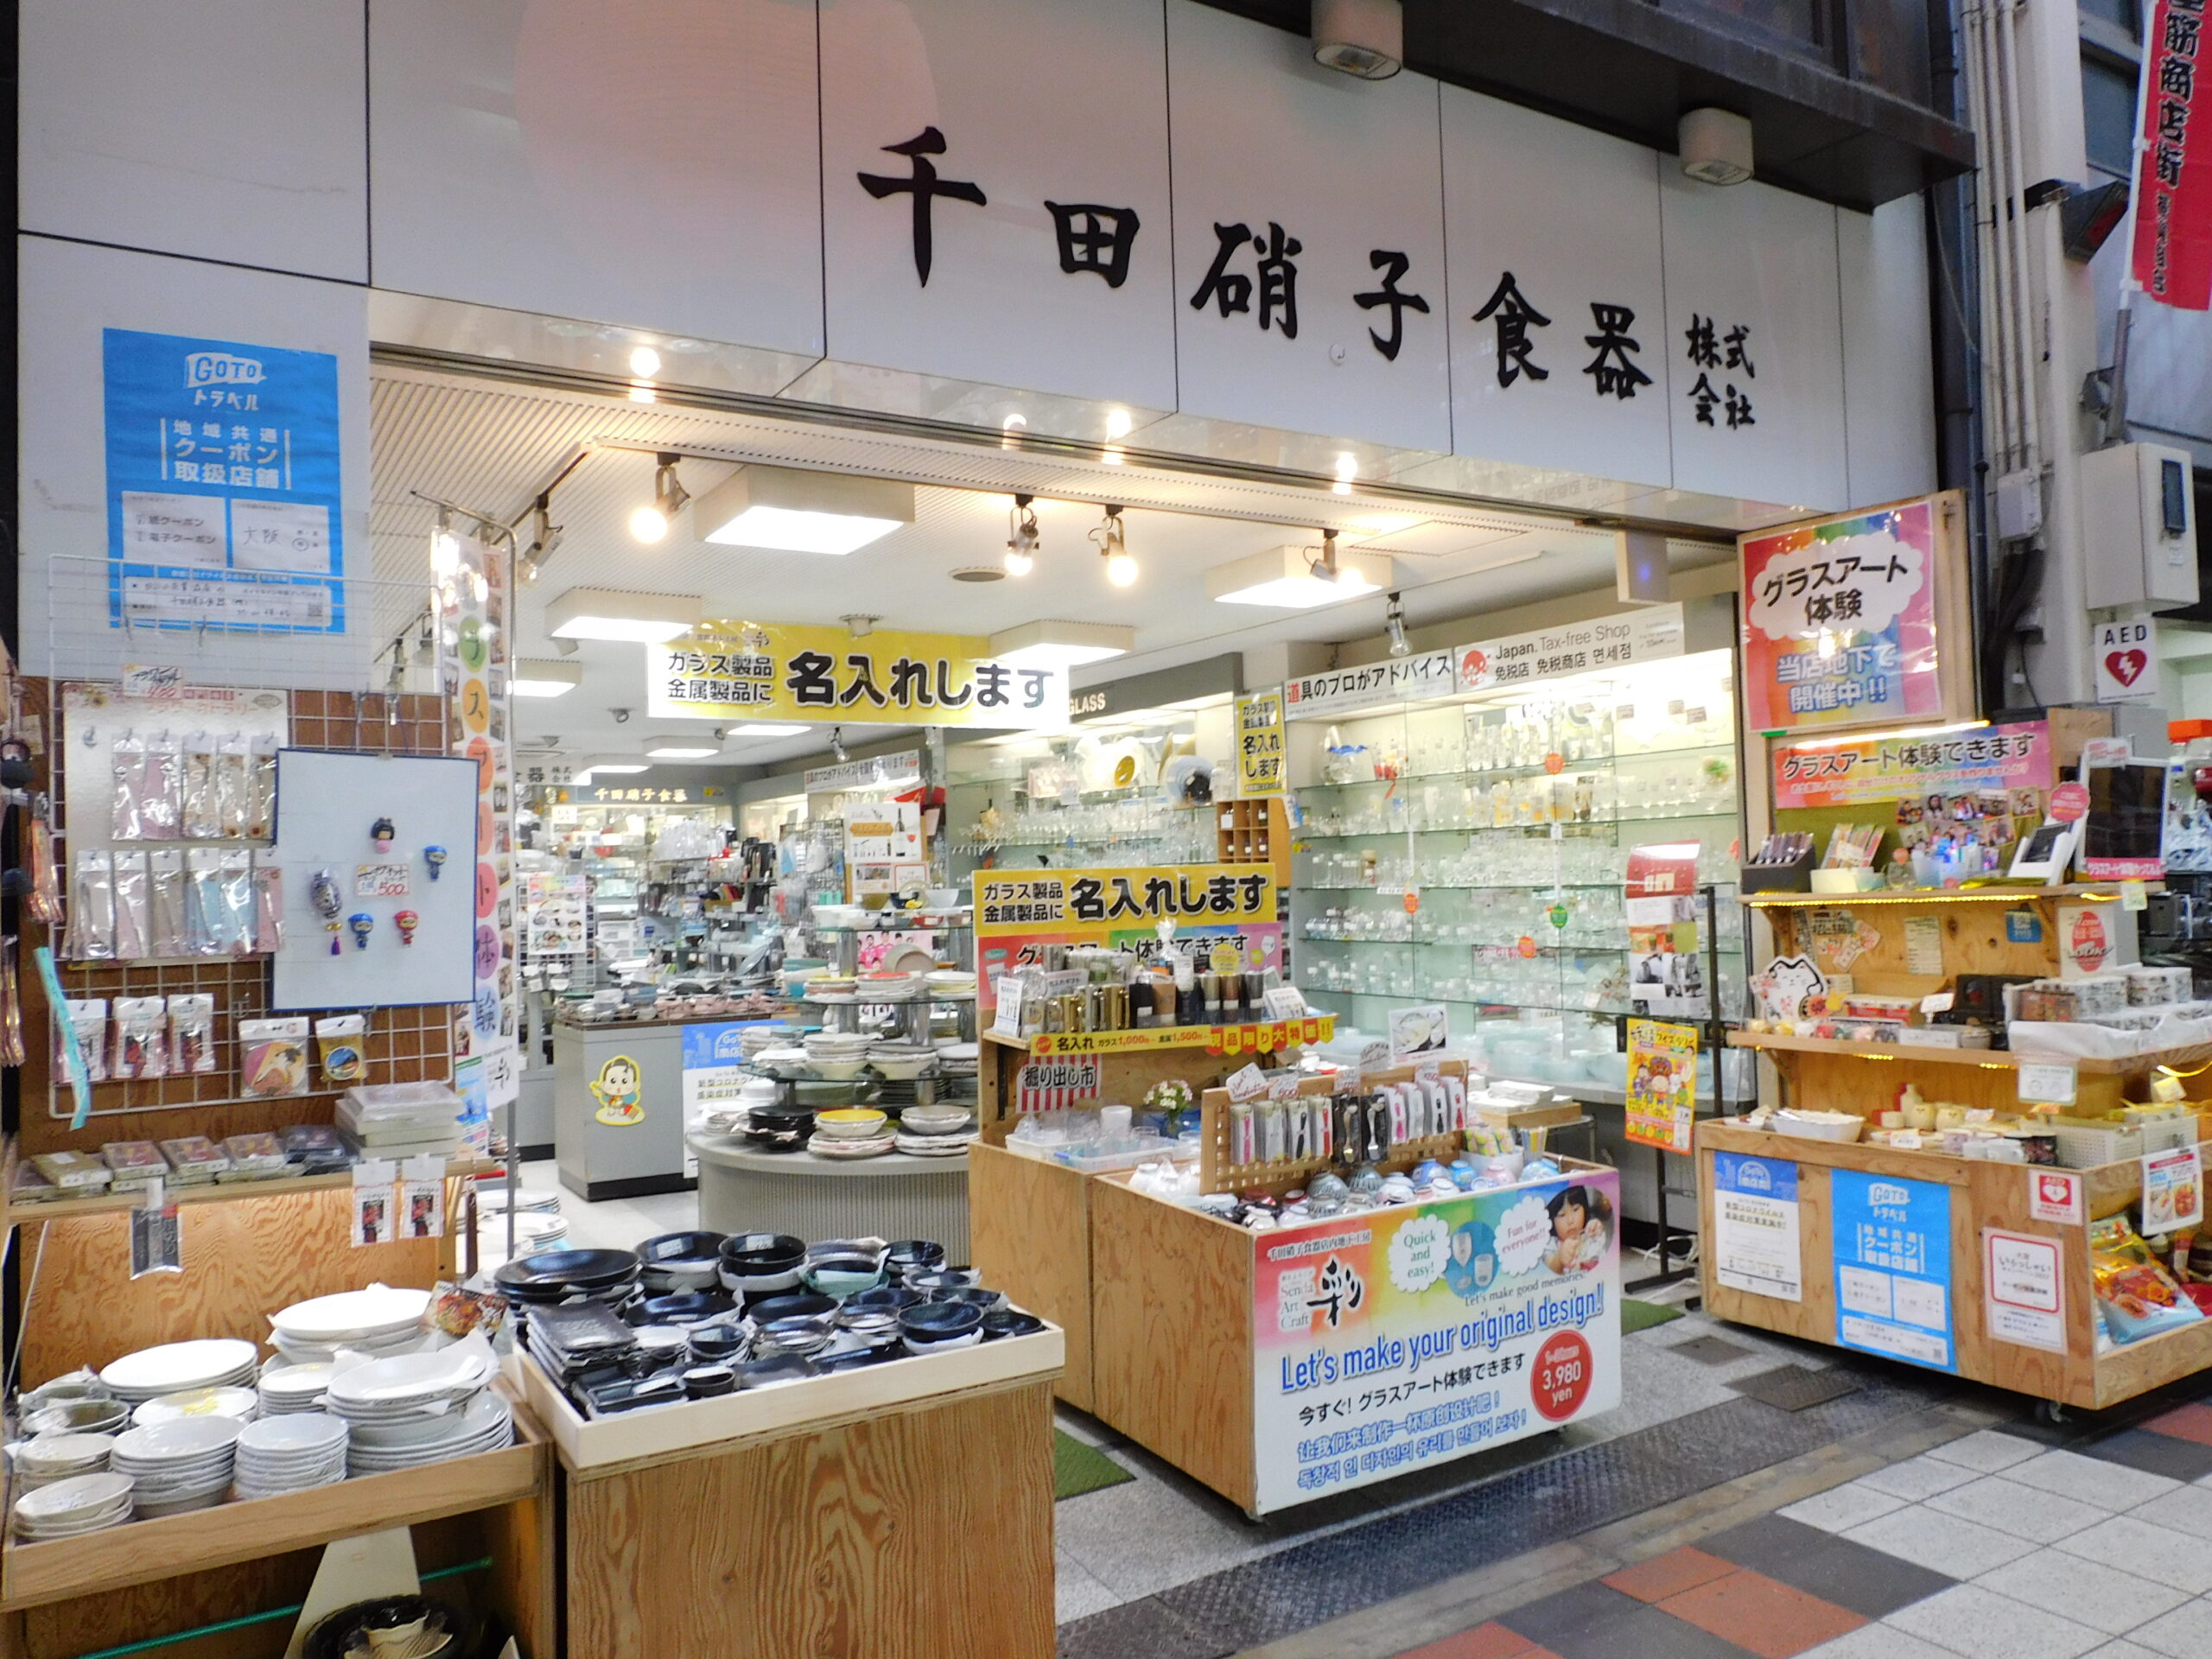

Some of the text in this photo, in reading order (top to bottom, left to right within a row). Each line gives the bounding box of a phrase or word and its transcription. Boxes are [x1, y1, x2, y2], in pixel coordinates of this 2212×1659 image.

[857, 126, 1653, 400] 千田硝子食器
[1685, 314, 1755, 378] 株式
[194, 390, 258, 410] トラベル
[1688, 373, 1756, 429] 会社
[173, 420, 277, 443] 地域共通
[175, 438, 277, 463] クーポン
[174, 461, 279, 489] 取扱店舗
[1763, 555, 1908, 607] グラスアート
[1805, 588, 1863, 626] 体験
[1540, 630, 1591, 653] Tax-free
[1595, 623, 1630, 642] Shop
[2104, 625, 2147, 646] AED
[669, 652, 772, 677] ガラス製品
[1495, 662, 1529, 682] 免税店
[1777, 642, 1897, 683] 当店地下で
[668, 679, 772, 702] 金属製品に
[787, 651, 1053, 709] 名入れします
[1287, 656, 1451, 703] 道具のプロがアドバイス
[1070, 692, 1106, 715] GLASS
[1243, 733, 1280, 755] 名入れ
[1783, 734, 2034, 779] グラスアート体験できます
[1245, 759, 1279, 778] します
[984, 882, 1063, 900] ガラス製品
[1071, 874, 1267, 919] 名入れします
[984, 904, 1063, 922] 金属製品に
[1058, 1038, 1094, 1051] 名入れ
[1025, 1066, 1095, 1087] 掘り出し市
[1404, 1230, 1436, 1247] Quick
[1508, 1219, 1536, 1236] Fun for
[1502, 1230, 1546, 1254] everyone!!
[1866, 1237, 1916, 1255] クーポン
[1411, 1249, 1430, 1261] and
[1408, 1262, 1434, 1278] easy!
[1281, 1284, 1313, 1297] Senda
[1465, 1294, 1486, 1306] Let's
[1490, 1287, 1513, 1300] make
[1517, 1281, 1539, 1297] good
[1281, 1301, 1299, 1313] Art
[1281, 1313, 1309, 1328] Craft
[1282, 1283, 1602, 1390] Let's make your original design!
[1542, 1361, 1581, 1390] 3,980
[1299, 1397, 1352, 1427] 今すぐ!
[1359, 1353, 1525, 1412] グラスアート体験できます
[1552, 1388, 1573, 1408] yen
